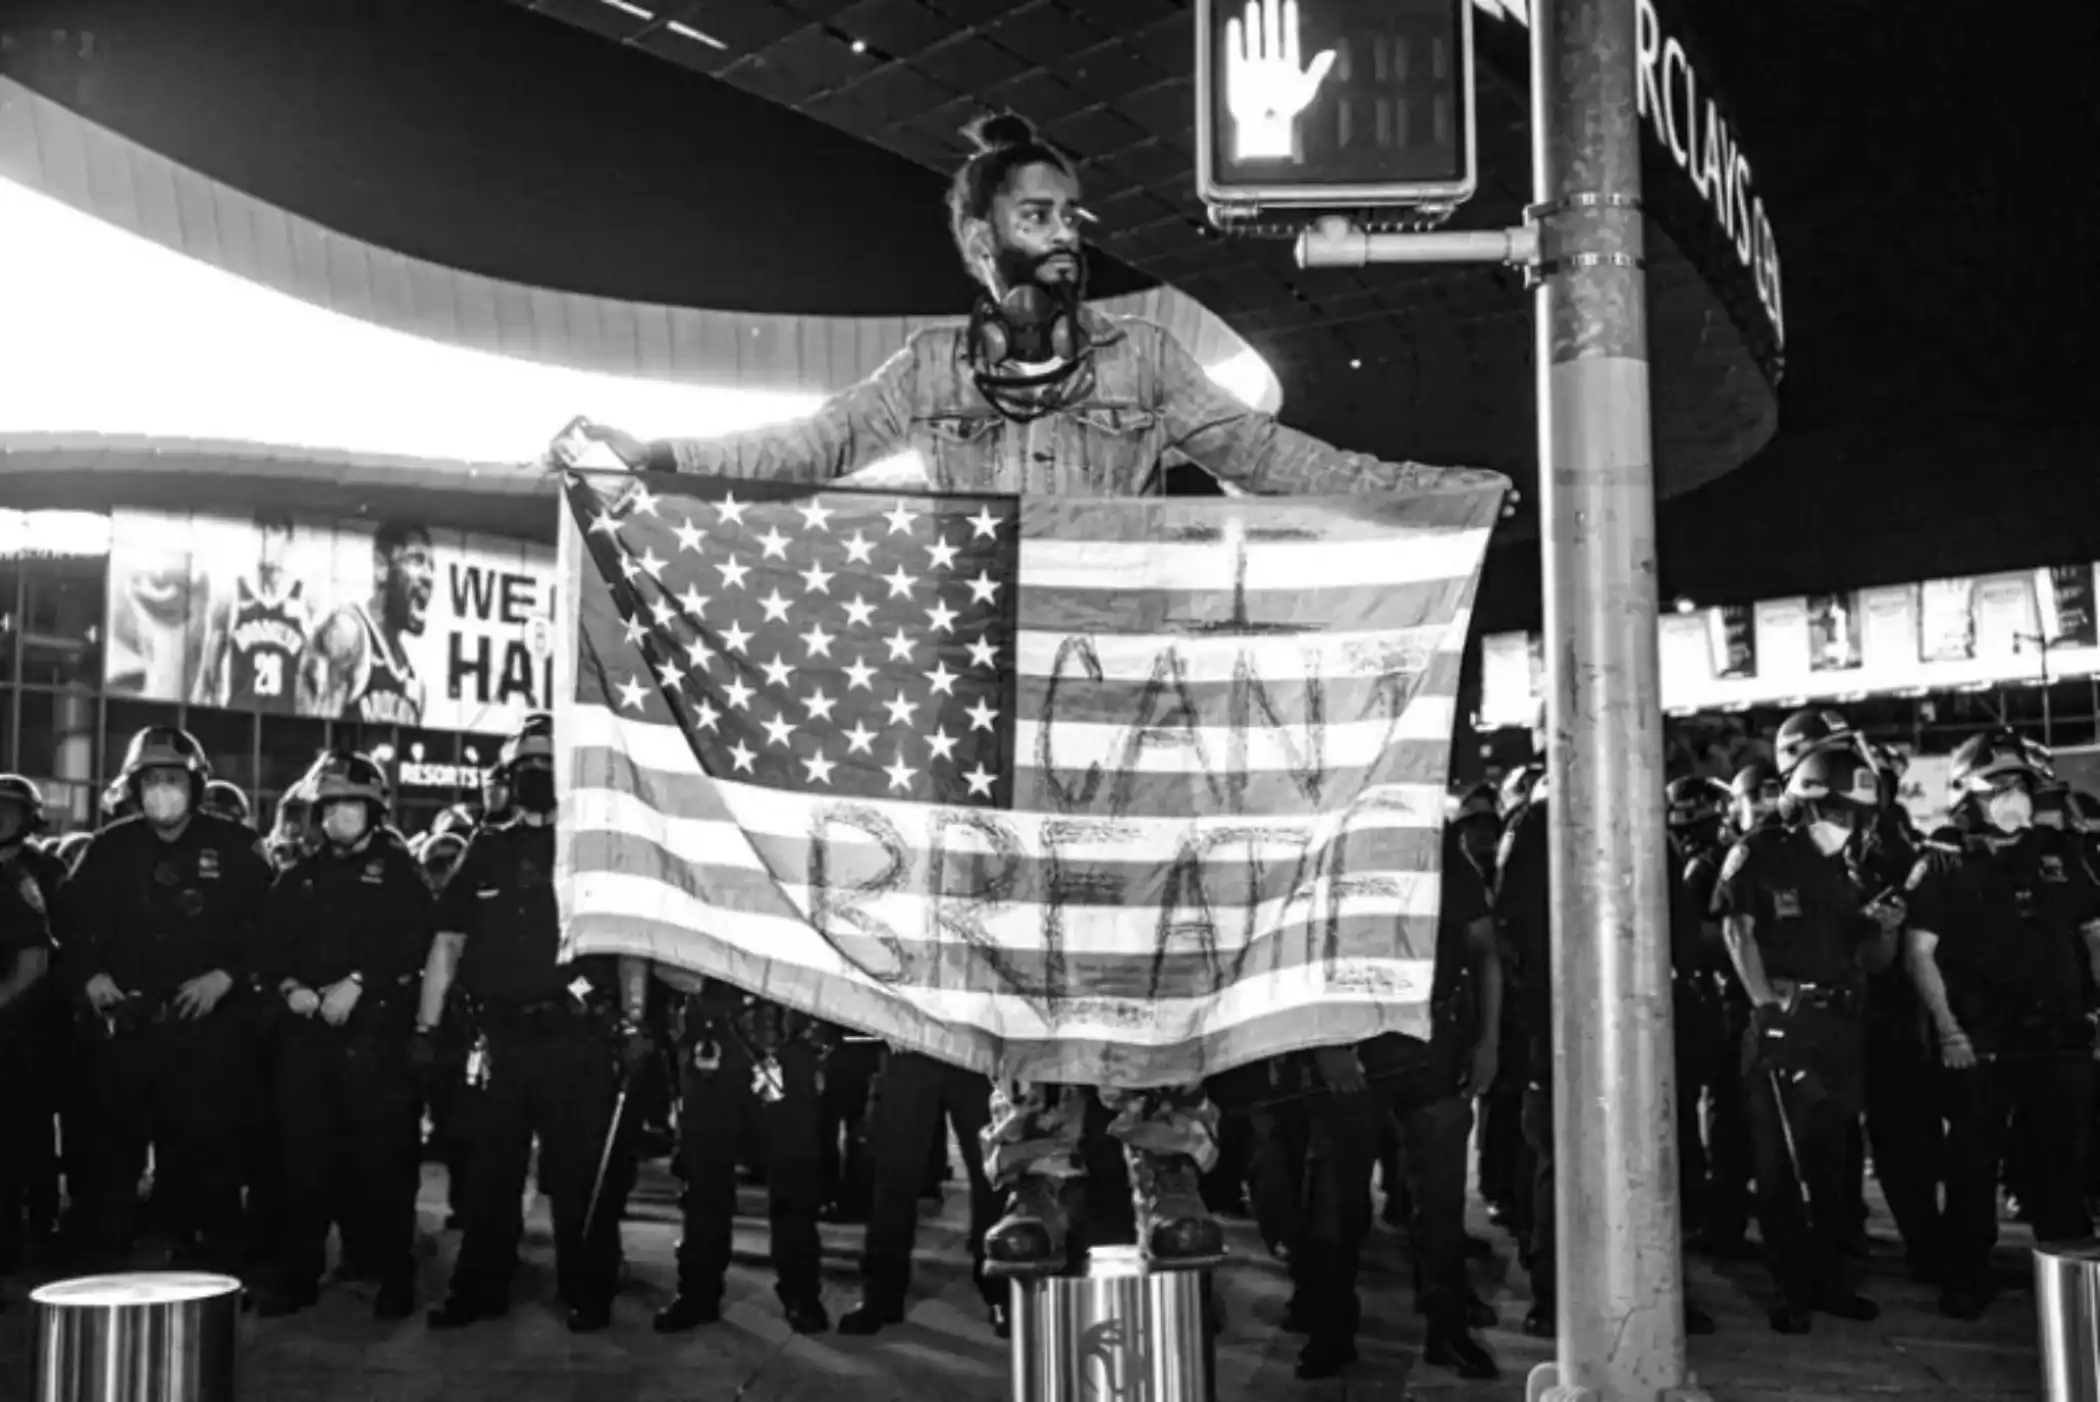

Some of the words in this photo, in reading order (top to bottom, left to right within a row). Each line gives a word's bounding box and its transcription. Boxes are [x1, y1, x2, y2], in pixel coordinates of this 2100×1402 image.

[1635, 0, 1751, 266] RCLAYS
[449, 562, 537, 624] WE
[1165, 526, 1328, 634] I
[806, 790, 1416, 1030] BREATHE
